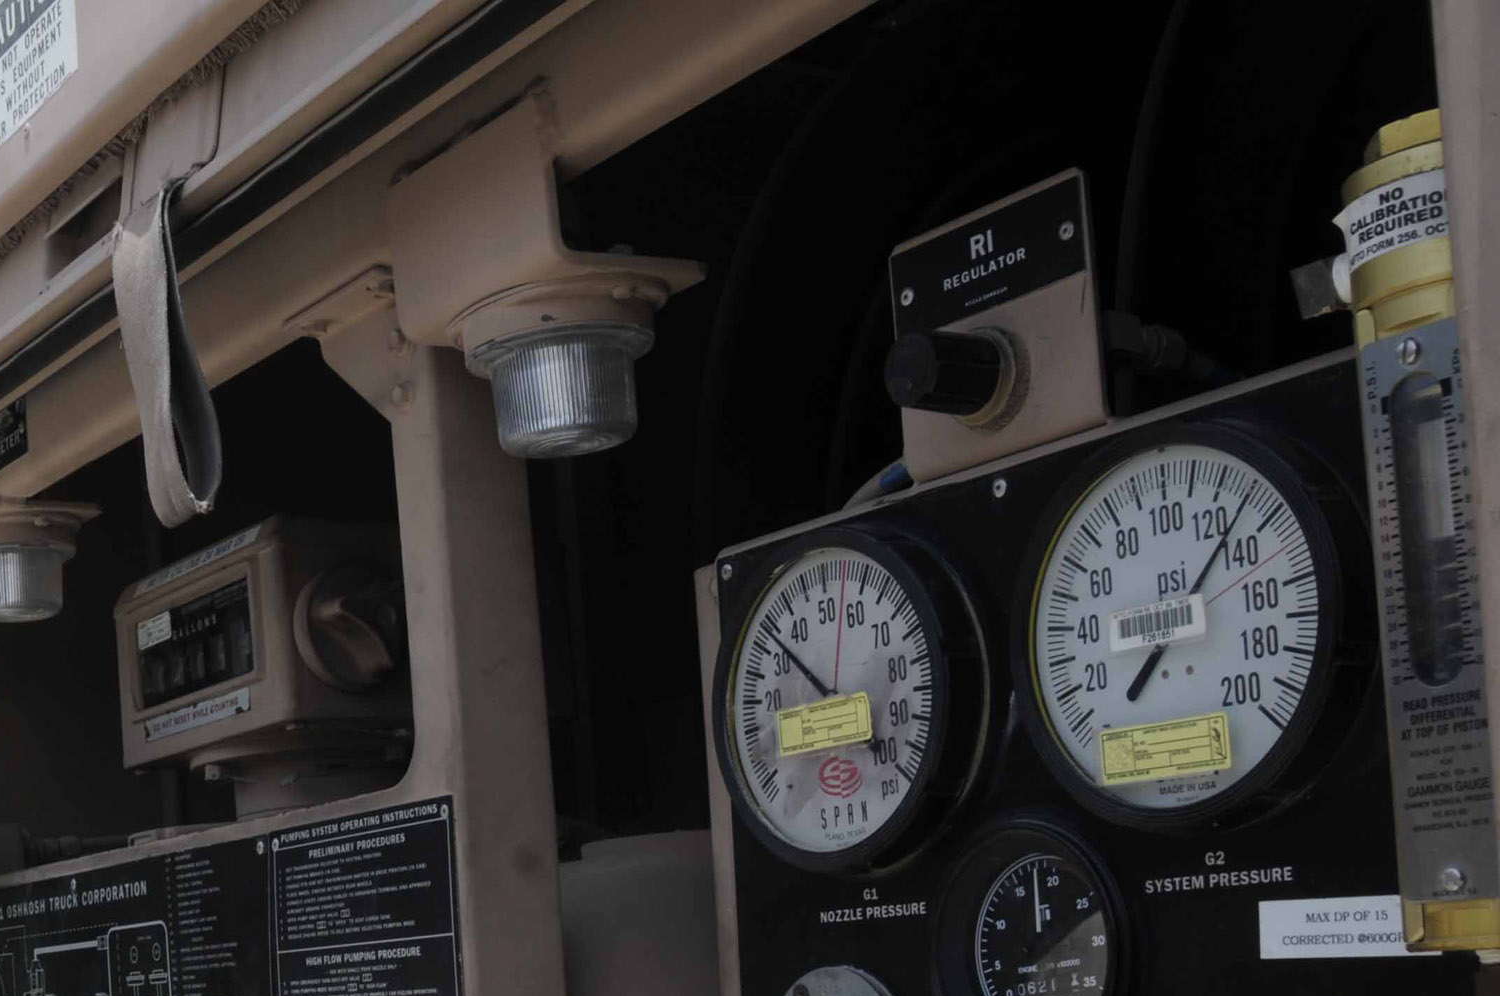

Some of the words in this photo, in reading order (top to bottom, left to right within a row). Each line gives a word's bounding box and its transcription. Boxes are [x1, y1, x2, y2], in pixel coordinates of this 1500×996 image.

[2, 46, 17, 72] NOT
[24, 2, 62, 49] OPERATE
[13, 23, 62, 83] EQUIPMENT
[6, 61, 45, 112] WITHOUT
[13, 62, 65, 124] PROTECTION
[1379, 188, 1403, 205] NO
[1359, 206, 1443, 245] REQUIRED
[1366, 238, 1394, 258] FORM
[943, 248, 1026, 291] REGULATOR
[1149, 502, 1183, 536] 100
[1192, 506, 1227, 541] 120
[1116, 527, 1138, 559] 80
[1223, 534, 1258, 571] 140
[1090, 567, 1112, 598] 60
[1157, 562, 1186, 598] psi
[1242, 577, 1278, 612] 160
[818, 597, 836, 624] 50
[846, 600, 865, 628] 60
[791, 617, 808, 643] 40
[871, 622, 890, 649] 70
[1077, 614, 1099, 644] 40
[1240, 625, 1279, 660] 180
[773, 652, 790, 676] 30
[888, 656, 907, 683] 80
[1085, 661, 1107, 691] 20
[1221, 671, 1261, 706] 200
[889, 699, 908, 726] 90
[881, 775, 899, 800] psi
[1159, 783, 1185, 795] MADE
[281, 828, 310, 843] PUMPING
[312, 823, 338, 837] SYSTEM
[341, 816, 379, 833] OPERATING
[383, 804, 437, 823] INSTRUCTIONS
[820, 800, 868, 829] SPAN
[309, 842, 354, 859] PRELIMINARY
[357, 833, 405, 850] PROCEDURES
[1205, 851, 1225, 866] G2
[1015, 886, 1025, 897] 15
[1047, 876, 1059, 886] 20
[1145, 875, 1204, 893] SYSTEM
[1210, 867, 1293, 888] PRESSURE
[7, 902, 45, 919] OSHKOSH
[50, 894, 78, 910] TRUCK
[81, 880, 147, 904] CORPORATION
[863, 888, 878, 900] G1
[1076, 898, 1089, 909] 25
[820, 907, 863, 923] NOZZLE
[866, 902, 926, 918] PRESSURE
[996, 920, 1005, 930] 10
[1306, 912, 1330, 923] MAX
[1334, 912, 1350, 922] DP
[1353, 911, 1370, 921] OF
[1375, 910, 1388, 920] 15
[1092, 935, 1105, 946] 30
[1282, 934, 1354, 946] CORRECTED
[306, 956, 322, 966] HIGH
[324, 954, 341, 964] FLOW
[344, 951, 376, 963] PUMPING
[378, 946, 421, 960] PROCEDURE
[1084, 976, 1096, 987] 35
